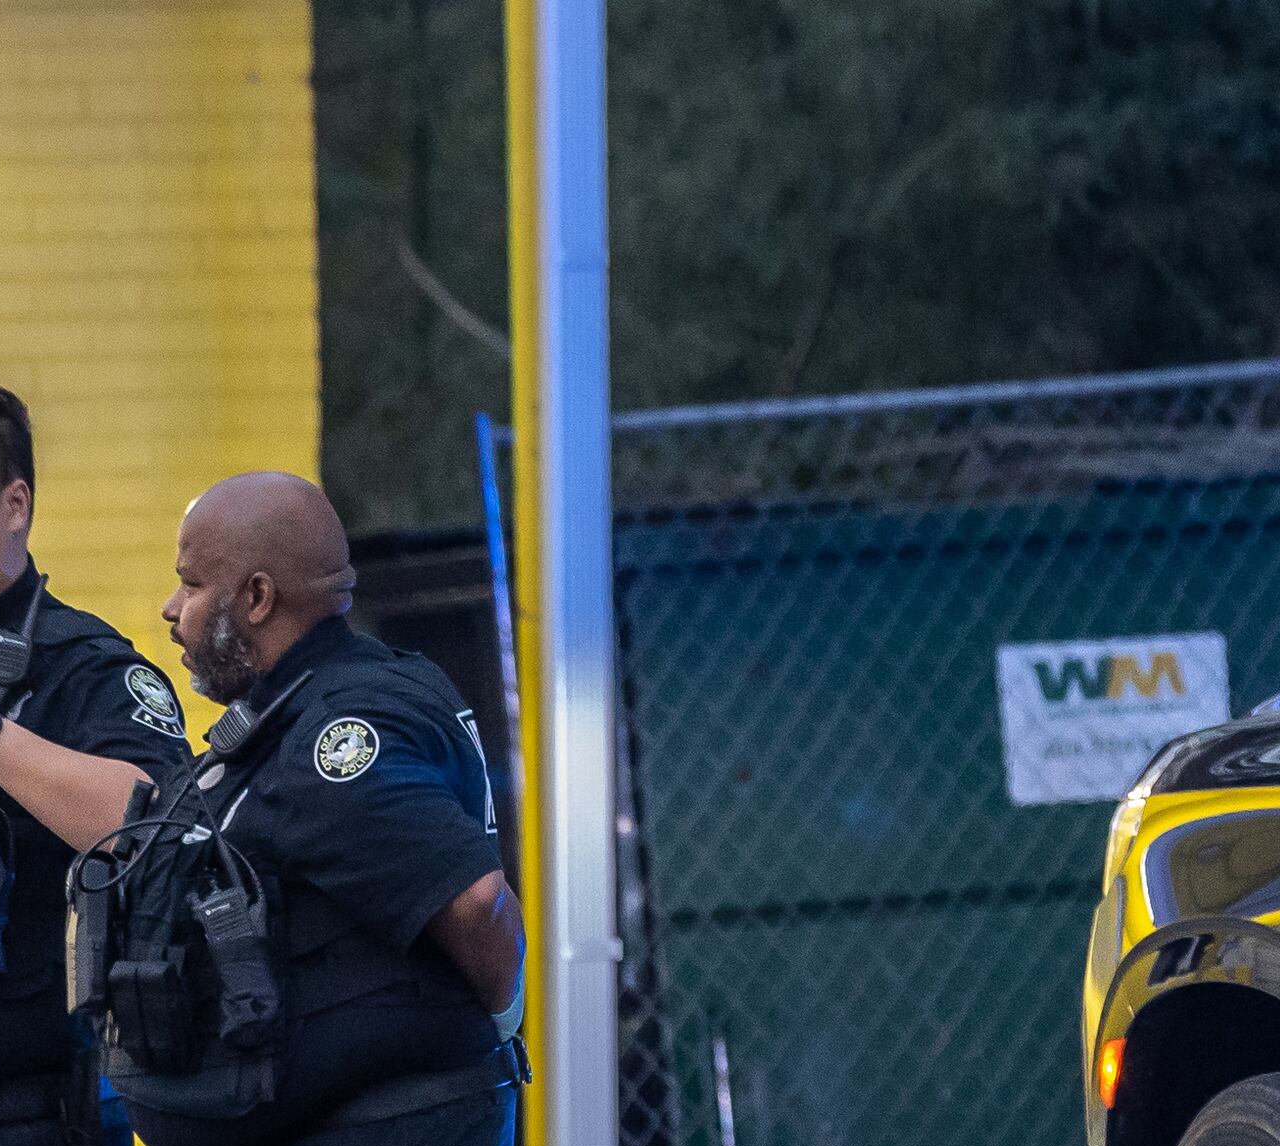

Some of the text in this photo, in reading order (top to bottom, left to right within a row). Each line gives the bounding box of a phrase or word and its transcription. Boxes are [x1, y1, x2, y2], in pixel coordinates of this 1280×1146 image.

[1032, 652, 1186, 703] WM
[319, 752, 332, 772] CITY
[329, 723, 368, 738] ATLANTA
[341, 746, 373, 776] POLICE
